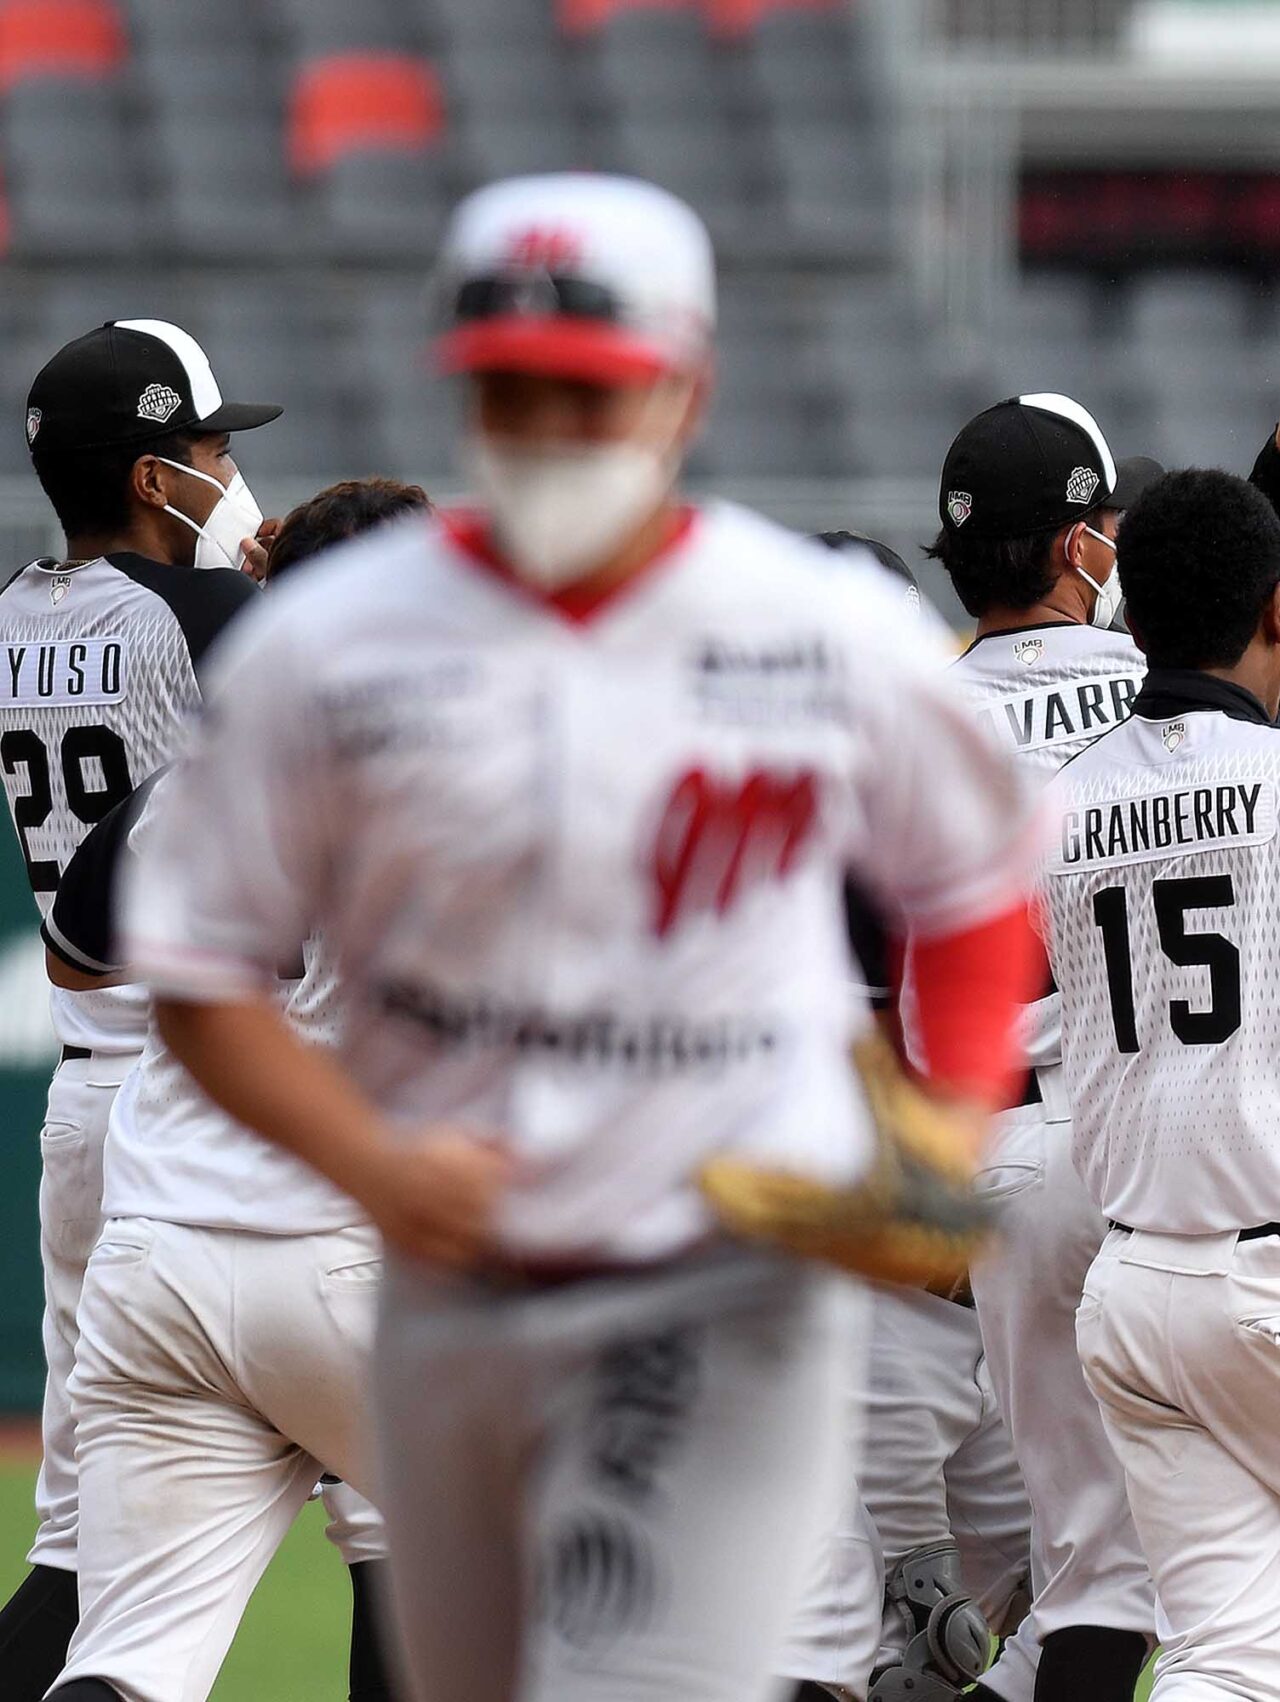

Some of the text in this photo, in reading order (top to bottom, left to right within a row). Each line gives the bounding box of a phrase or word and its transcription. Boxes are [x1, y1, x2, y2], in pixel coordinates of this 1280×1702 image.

[7, 643, 121, 698] YUSO
[1014, 639, 1043, 654] LMB
[1163, 723, 1185, 738] LMB
[1062, 783, 1262, 864] GRANBERRY
[1093, 873, 1241, 1054] 15
